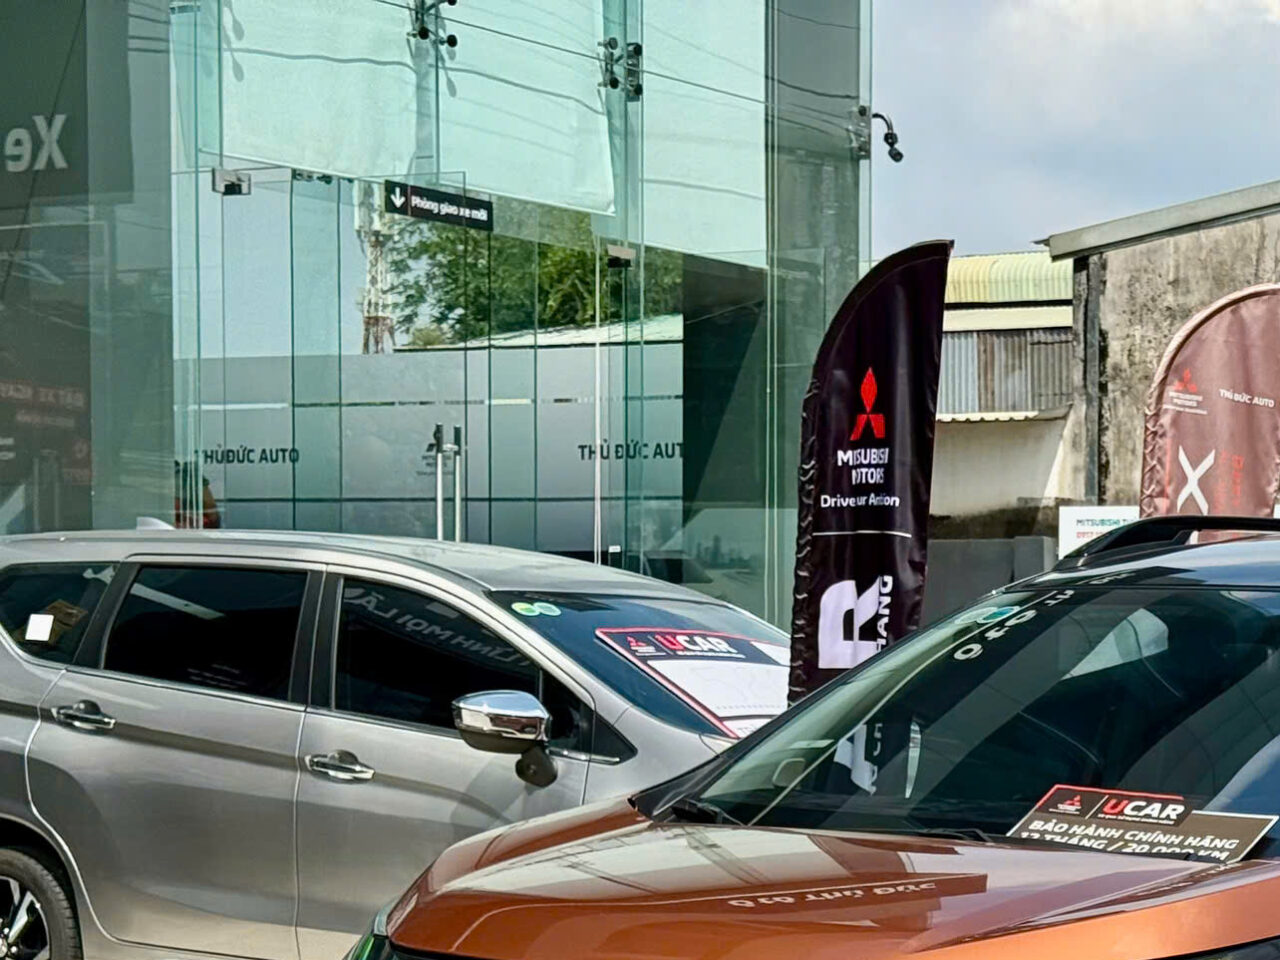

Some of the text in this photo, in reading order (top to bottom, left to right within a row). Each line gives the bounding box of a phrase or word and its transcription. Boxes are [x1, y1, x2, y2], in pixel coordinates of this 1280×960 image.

[259, 448, 299, 464] AUTO
[655, 634, 738, 653] UCAR
[1103, 799, 1185, 819] UCAR
[1028, 817, 1240, 850] BẢO HÀNH CHÍNH HÃNG
